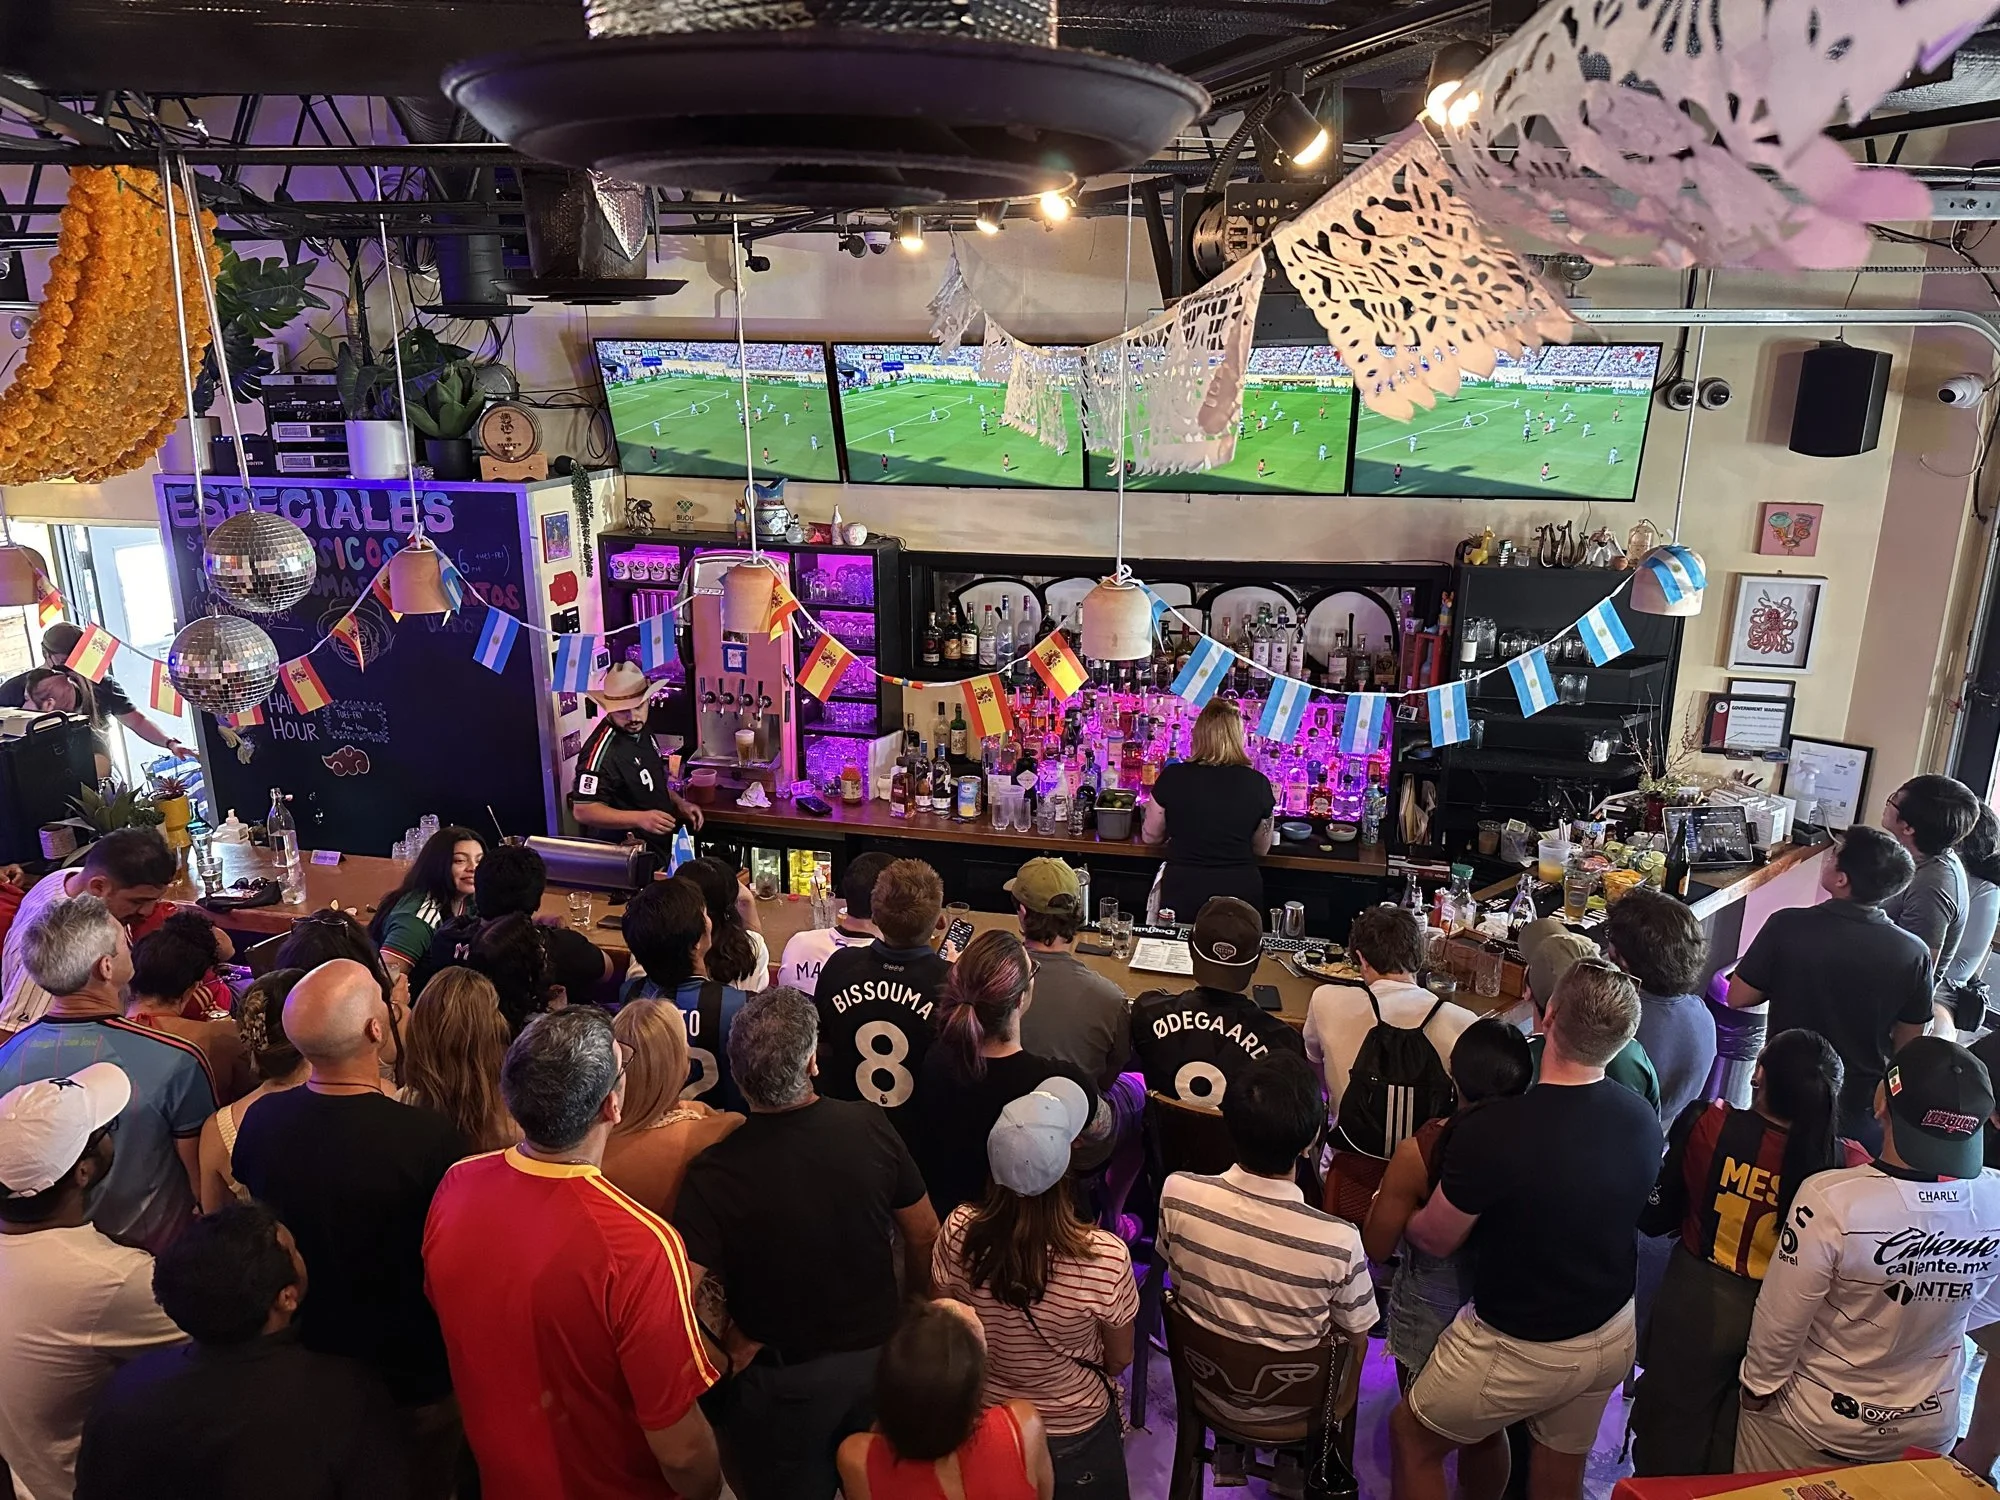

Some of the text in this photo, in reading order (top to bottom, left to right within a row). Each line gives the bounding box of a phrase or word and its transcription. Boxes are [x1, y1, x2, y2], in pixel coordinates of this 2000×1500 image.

[270, 717, 320, 741] HOUR
[639, 768, 654, 792] 9
[831, 980, 935, 1021] BISSOUMA
[855, 1021, 914, 1108] 8
[1918, 1190, 1959, 1202] CHARLY
[1778, 1249, 1798, 1266] Berel
[1885, 1259, 1992, 1276] caliente.mx
[1914, 1281, 1973, 1299] INTER
